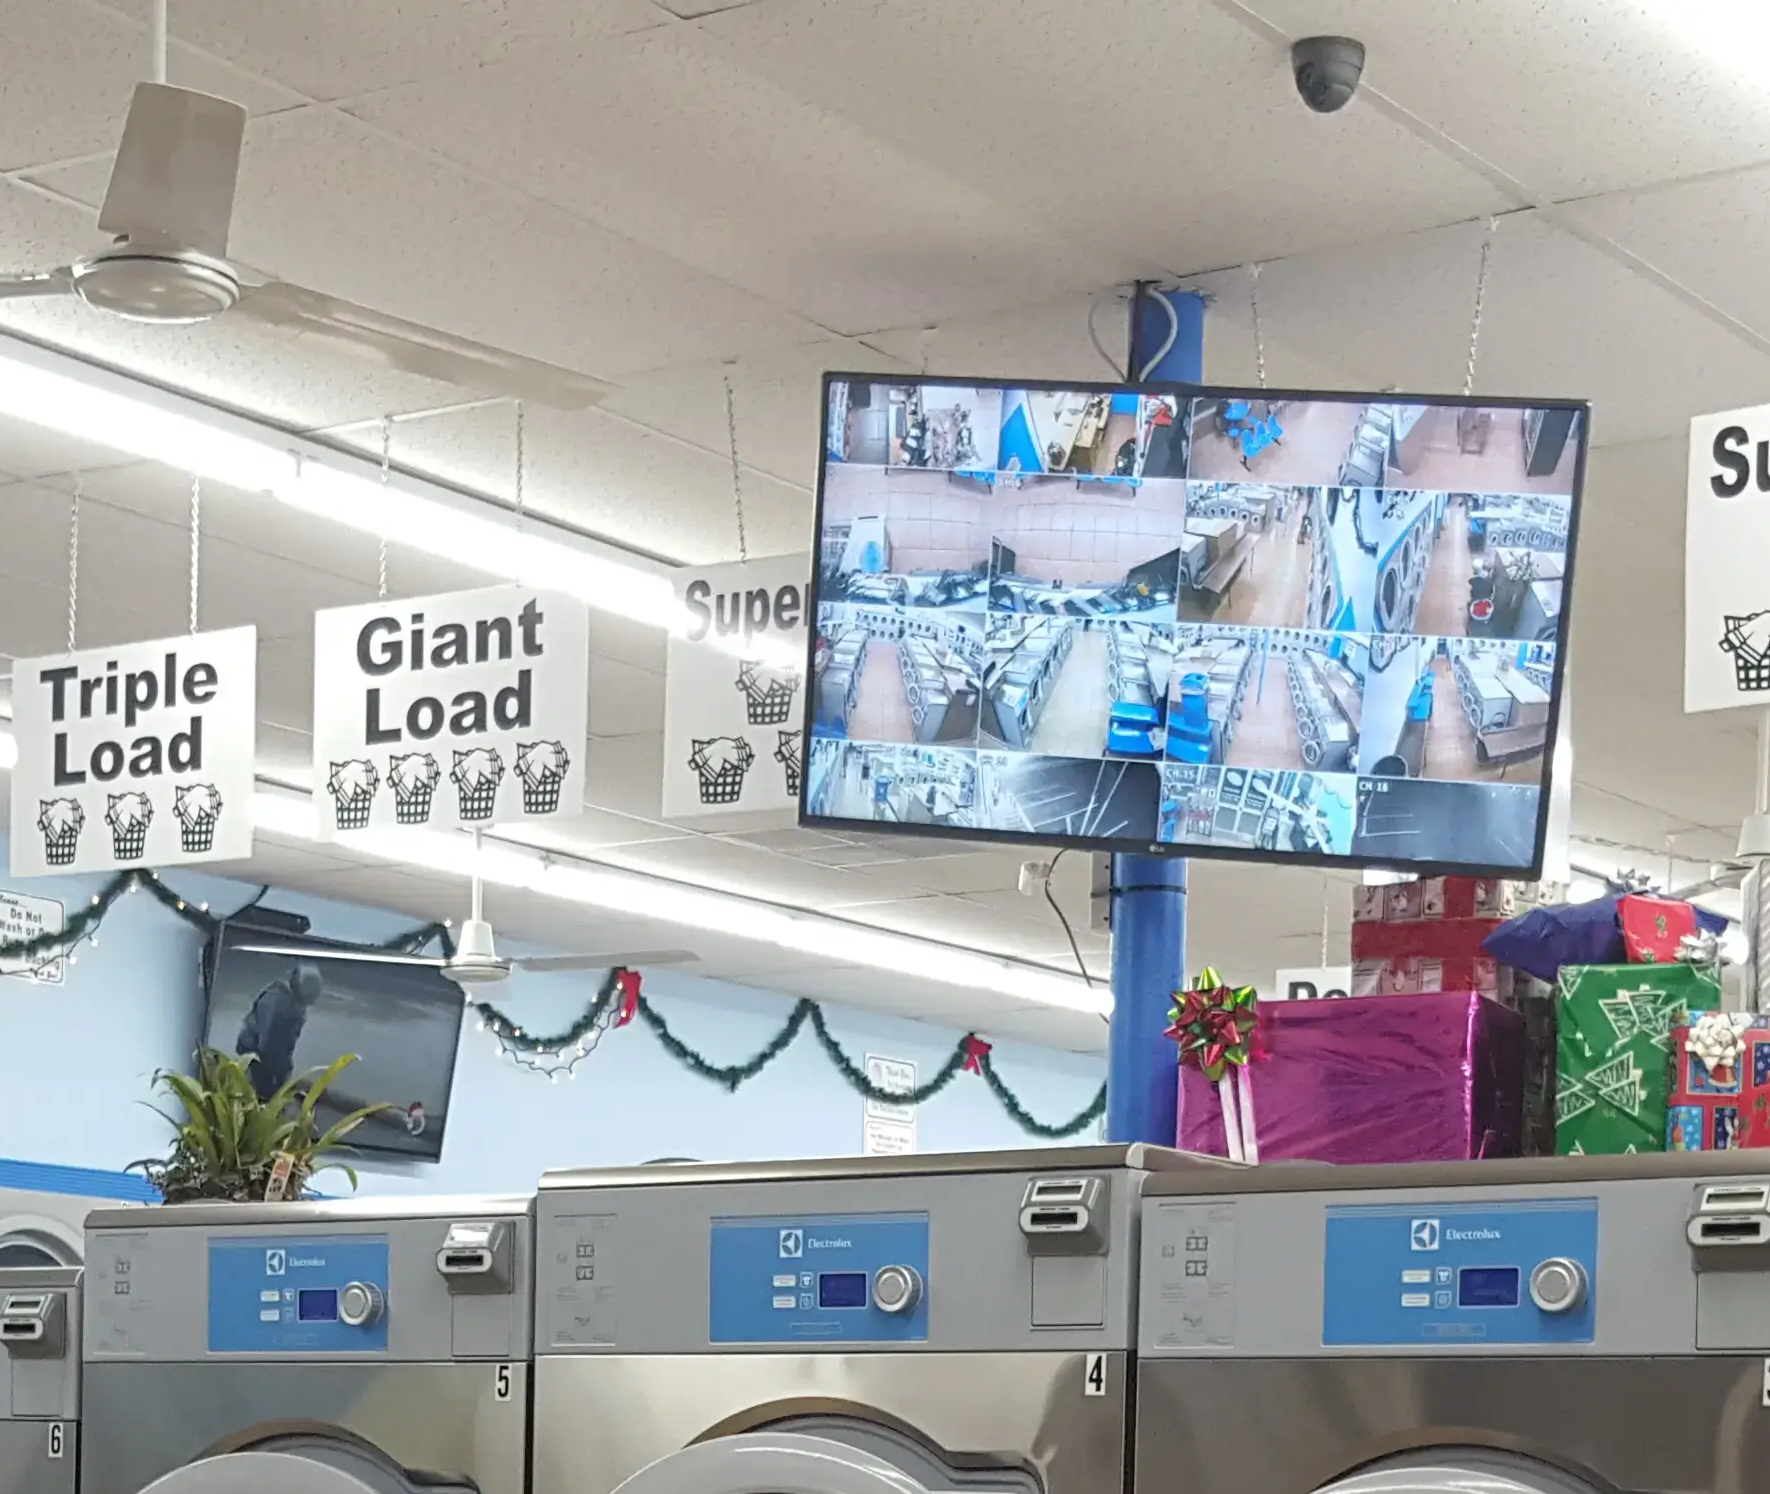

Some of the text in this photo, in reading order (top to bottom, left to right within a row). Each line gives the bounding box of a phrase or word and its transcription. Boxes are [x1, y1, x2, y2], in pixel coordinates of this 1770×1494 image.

[354, 597, 545, 677] Giant
[39, 651, 219, 729] Triple
[364, 669, 533, 745] Load
[52, 716, 203, 785] Load
[807, 1238, 853, 1250] Electrolux
[1445, 1227, 1501, 1242] Electrolux
[497, 1365, 510, 1398] 5
[1088, 1355, 1105, 1392] 4
[50, 1424, 62, 1454] 6
